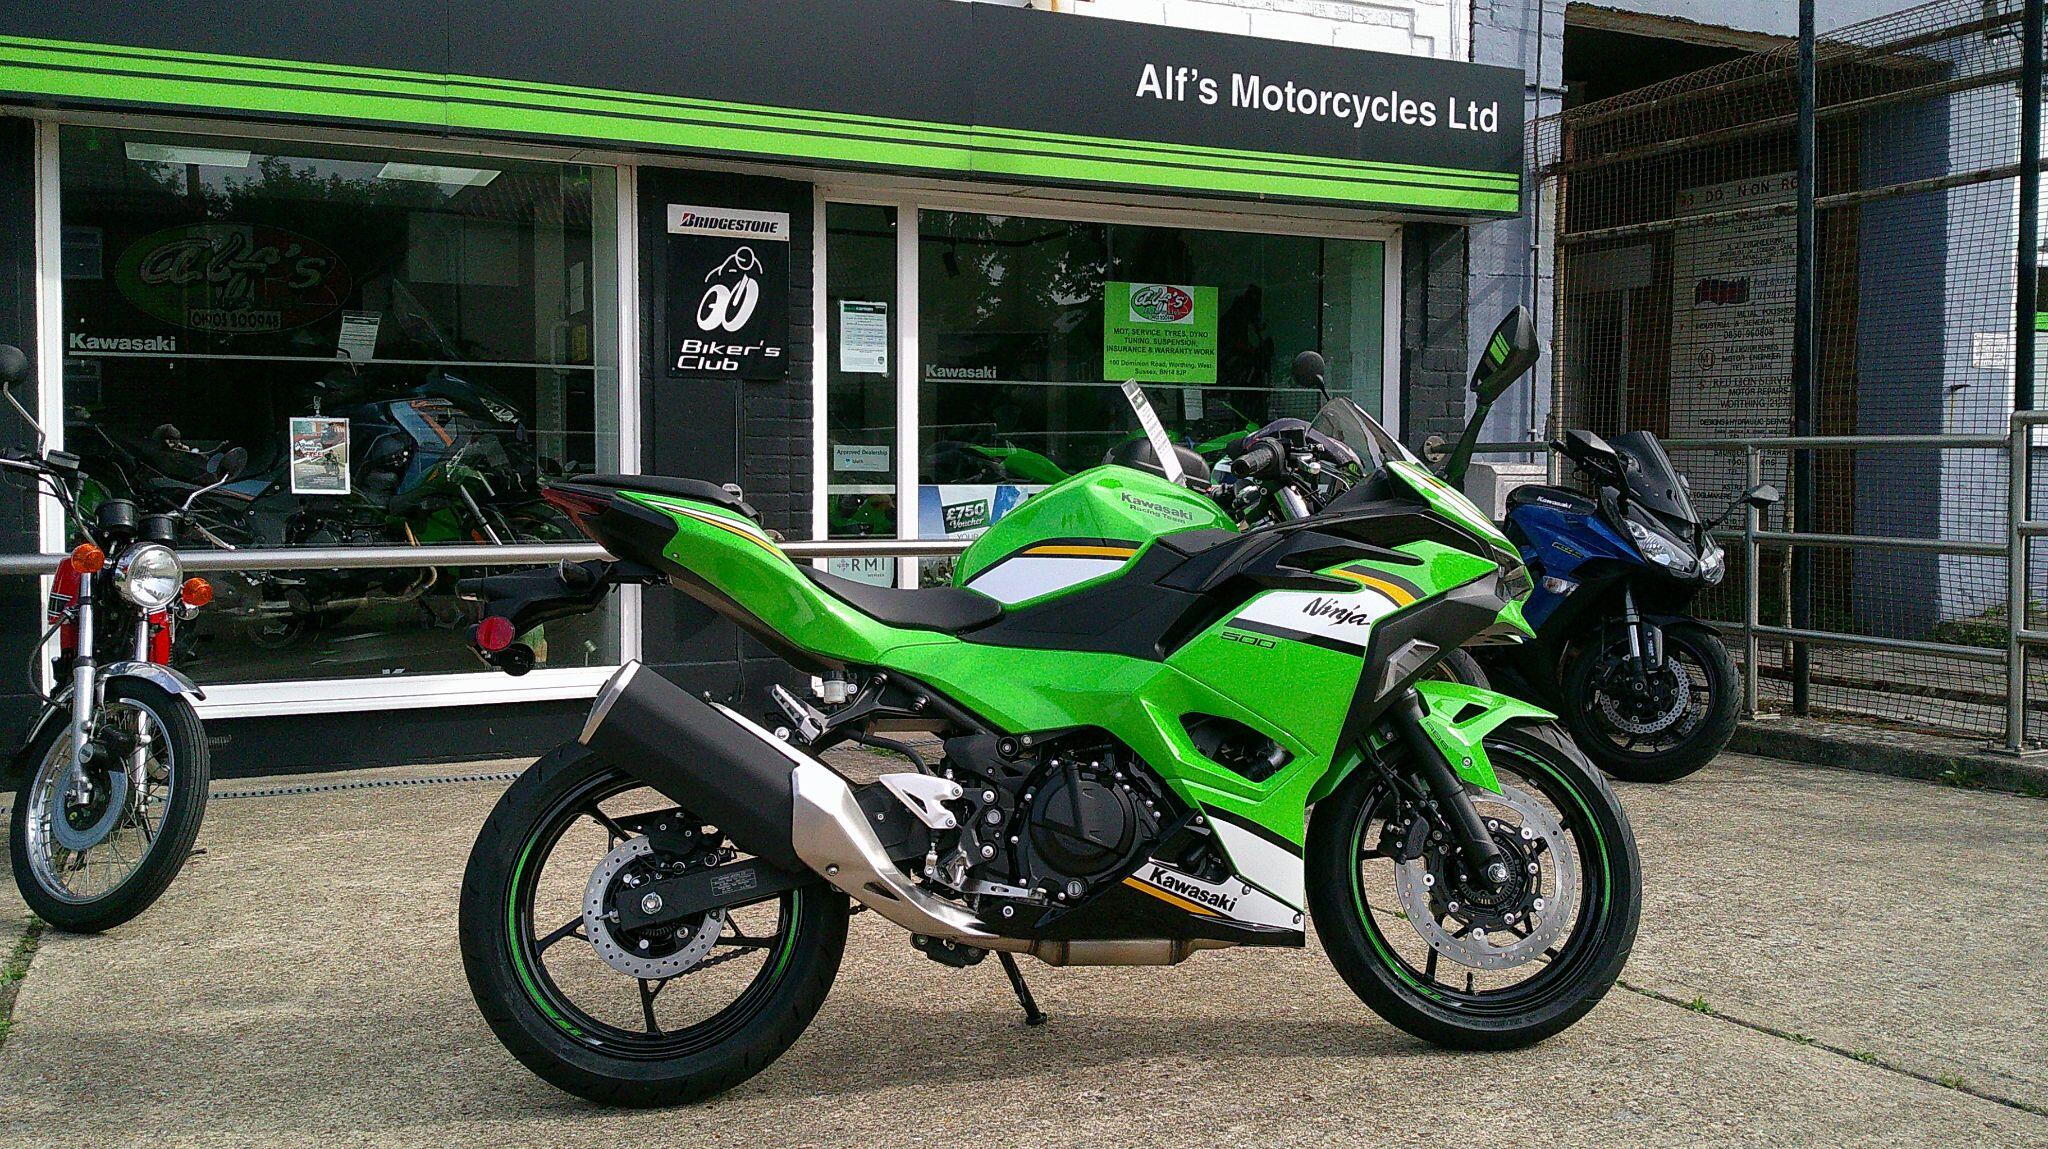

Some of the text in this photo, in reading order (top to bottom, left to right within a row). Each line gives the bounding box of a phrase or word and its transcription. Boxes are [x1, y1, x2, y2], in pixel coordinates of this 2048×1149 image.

[1135, 62, 1499, 133] Alf's Motorcycles Ltd
[680, 212, 779, 235] BRIDGESTONE
[69, 332, 176, 352] Kawasaki
[1106, 344, 1146, 354] INSURANCE
[1154, 346, 1193, 356] WARRANTY
[1193, 347, 1215, 356] WORK
[677, 355, 739, 372] Club
[925, 363, 997, 379] Kawasaki
[1728, 387, 1755, 396] MOTOR
[1720, 399, 1765, 408] WORTHING
[945, 501, 985, 521] £750
[1121, 492, 1193, 521] Kawasaki
[1536, 495, 1573, 509] Kawasaki
[949, 516, 985, 530] Voucher
[1129, 504, 1186, 524] Racing Team
[851, 557, 885, 572] RMI
[1302, 597, 1371, 627] Ninja
[1220, 631, 1277, 650] 500
[1149, 866, 1238, 913] Kawasaki
